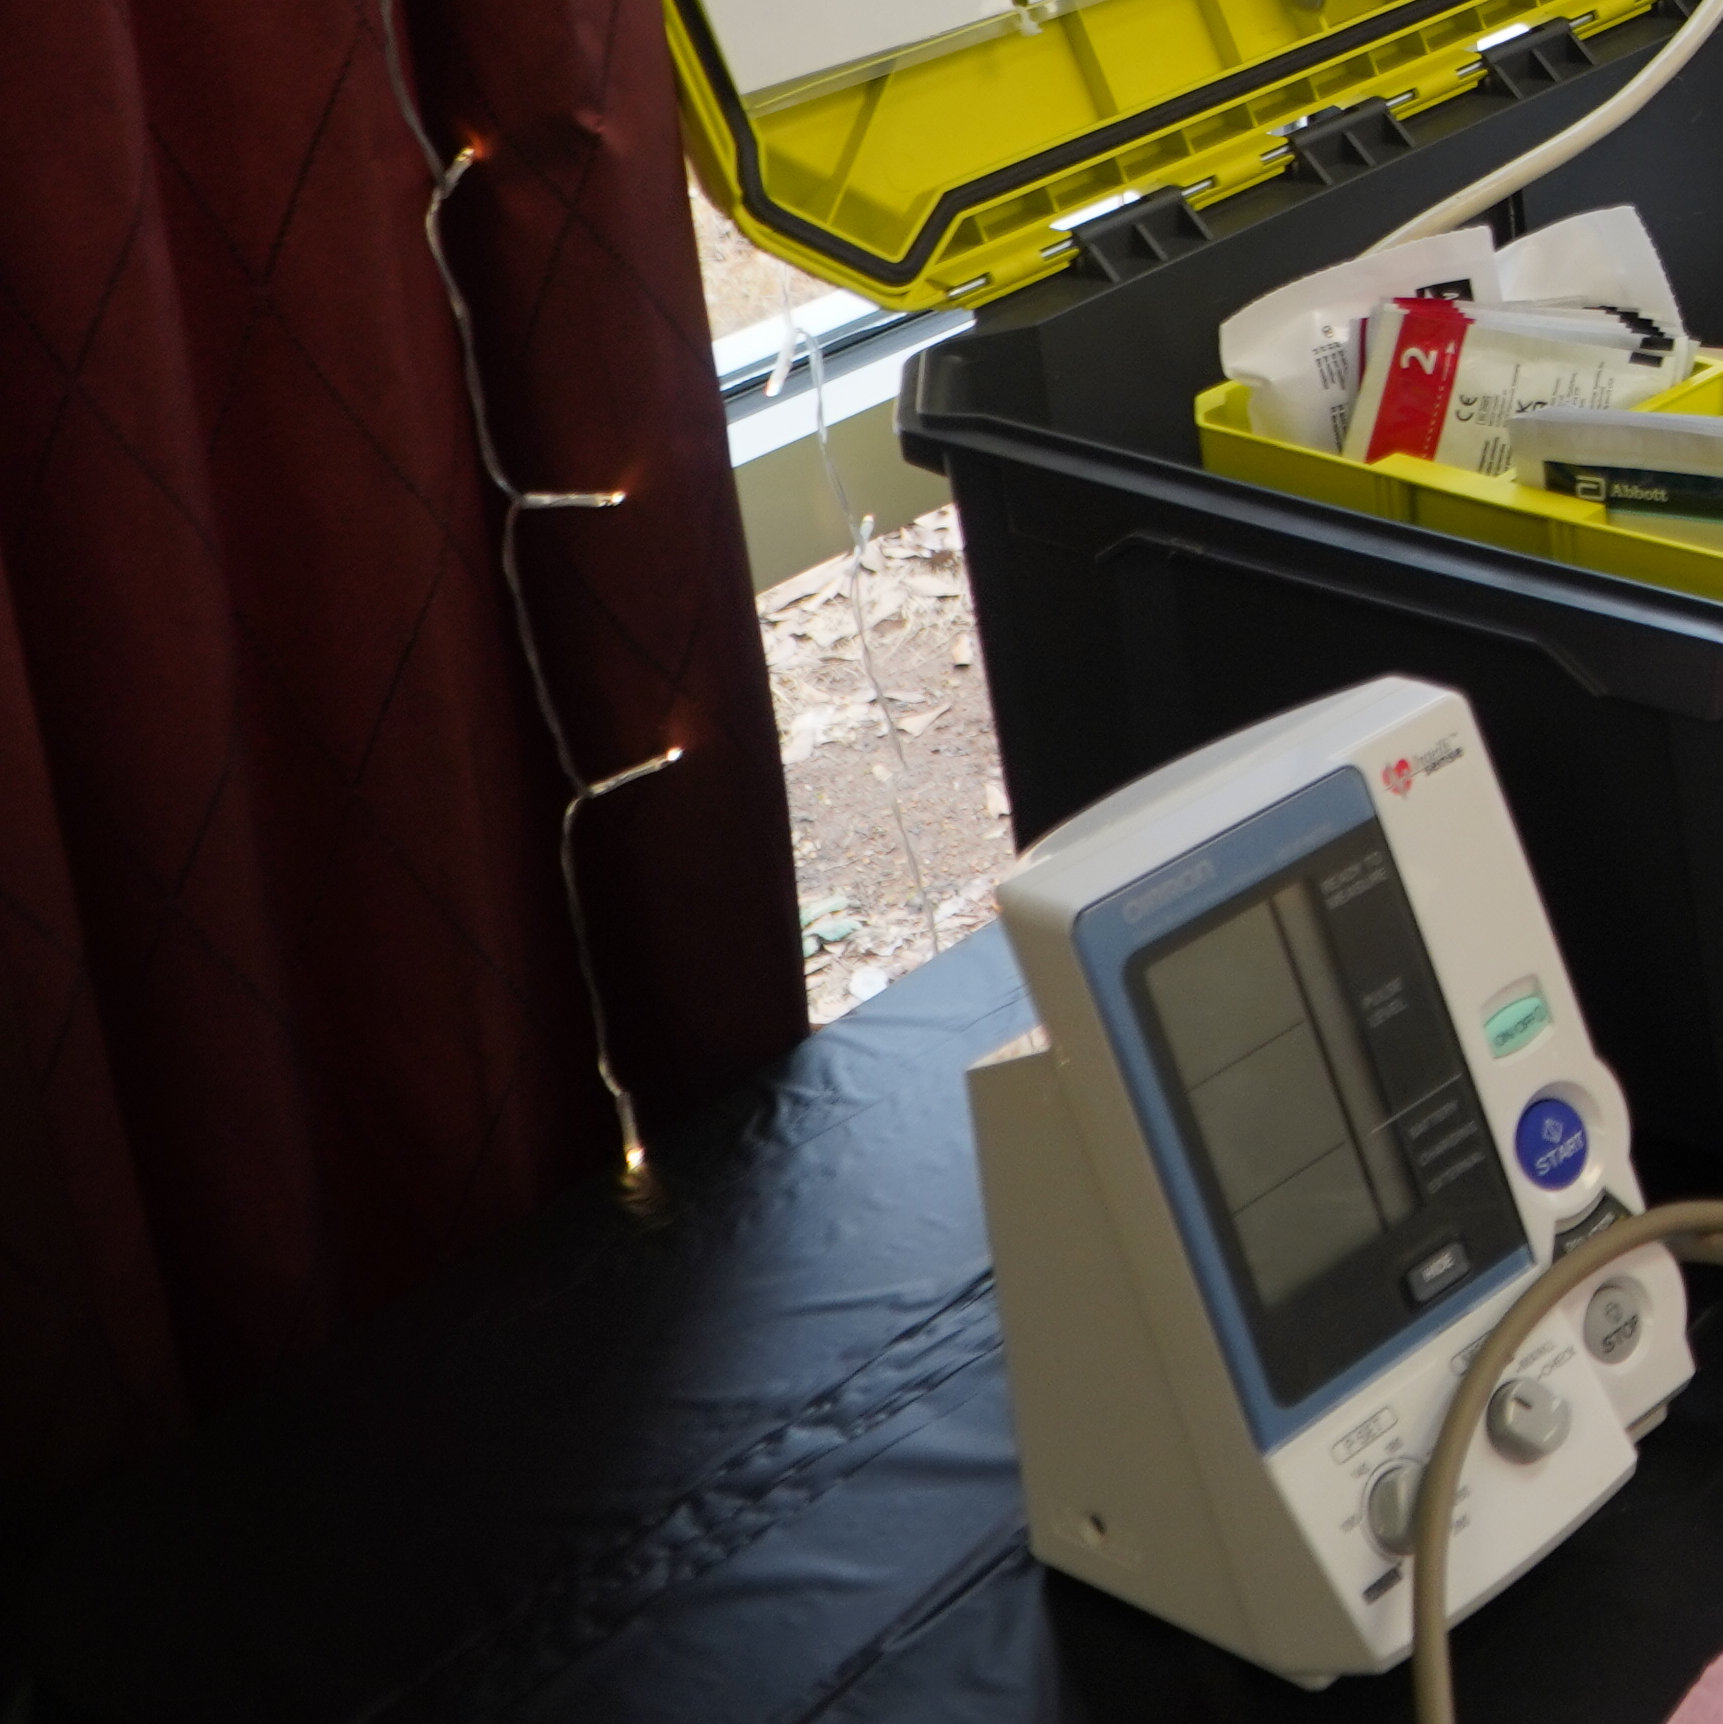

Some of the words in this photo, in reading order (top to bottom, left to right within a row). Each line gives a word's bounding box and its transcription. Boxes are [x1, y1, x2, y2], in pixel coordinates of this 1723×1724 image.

[1401, 346, 1438, 374] 2
[1611, 482, 1667, 504] Abbott
[1534, 1130, 1584, 1176] START
[1422, 1251, 1454, 1283] HIDE
[1601, 1314, 1640, 1355] STOP
